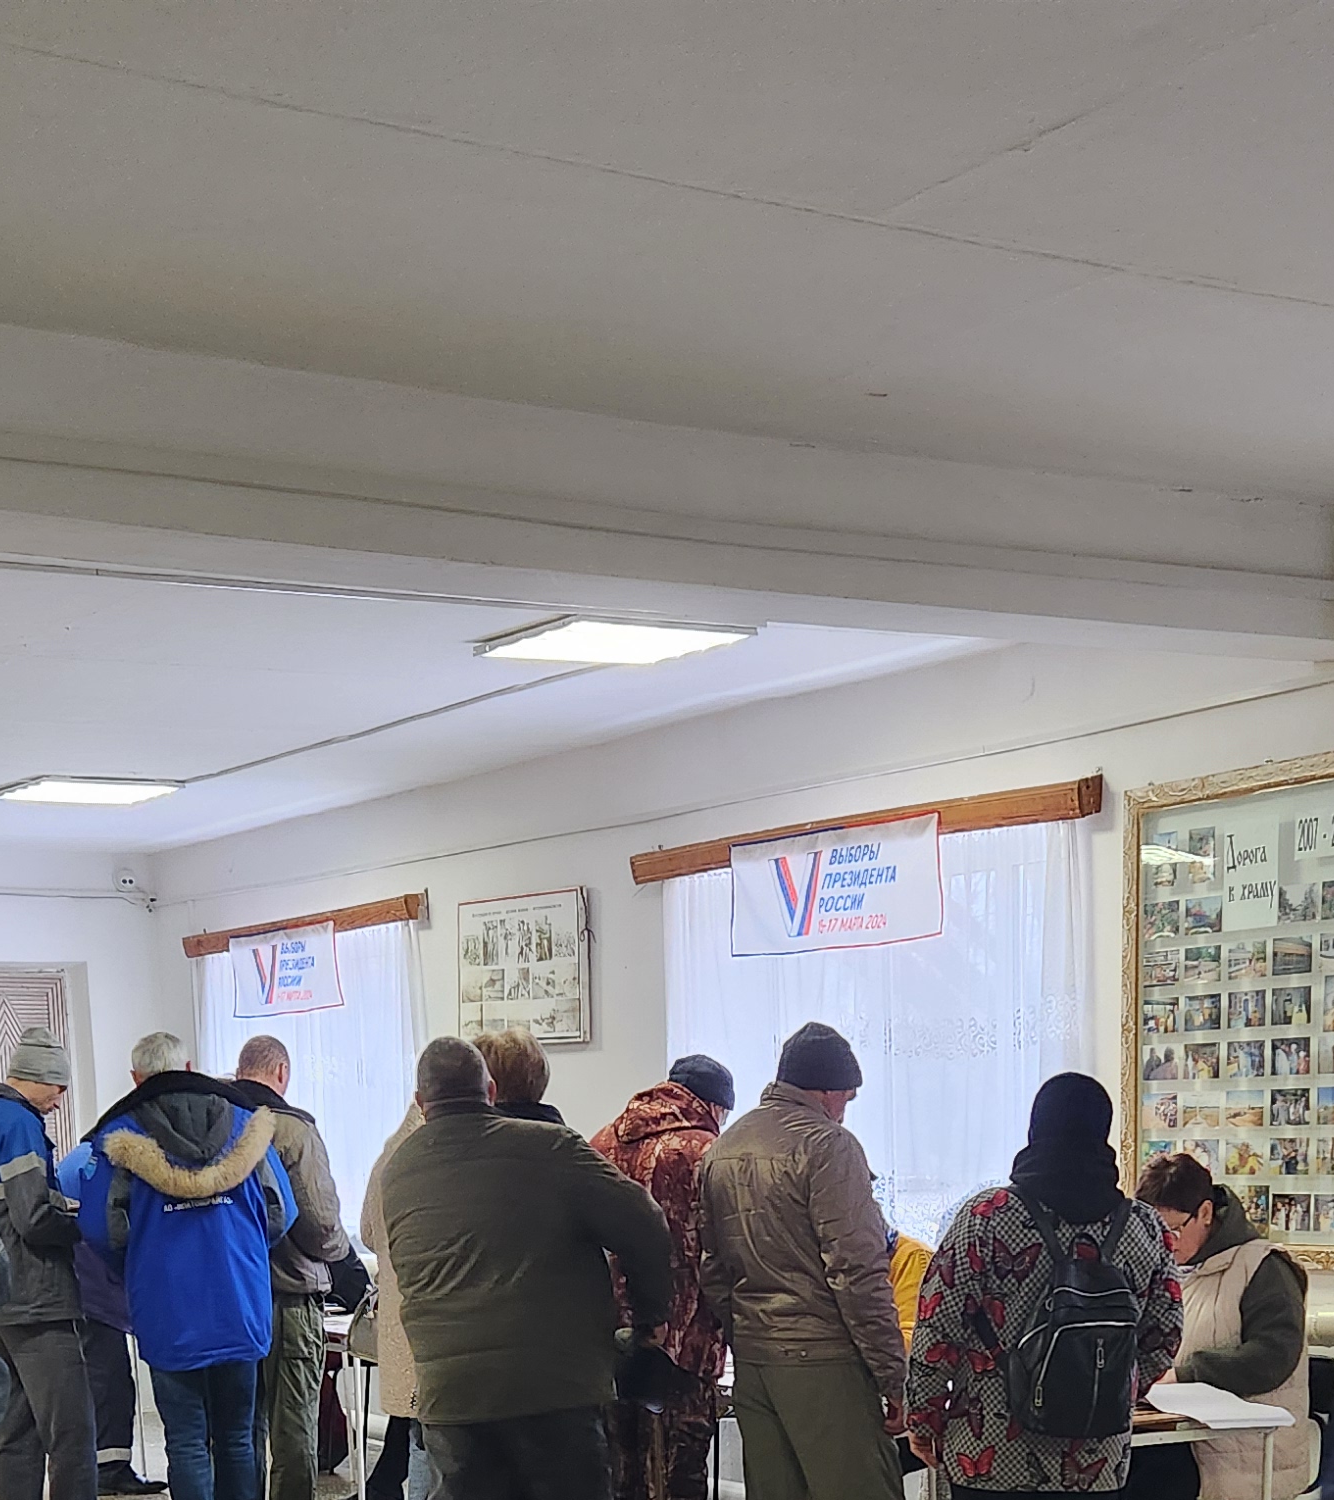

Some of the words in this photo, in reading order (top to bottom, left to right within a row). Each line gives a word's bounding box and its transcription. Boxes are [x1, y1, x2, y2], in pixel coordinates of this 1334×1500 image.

[1297, 817, 1319, 852] 2007
[828, 842, 882, 866] ВЫБОРЫ
[1226, 834, 1268, 873] Дорога
[821, 865, 897, 890] ПРЕЗИДЕНТА
[819, 892, 865, 914] РОССИИ
[1228, 885, 1235, 903] к
[1240, 880, 1277, 909] храму
